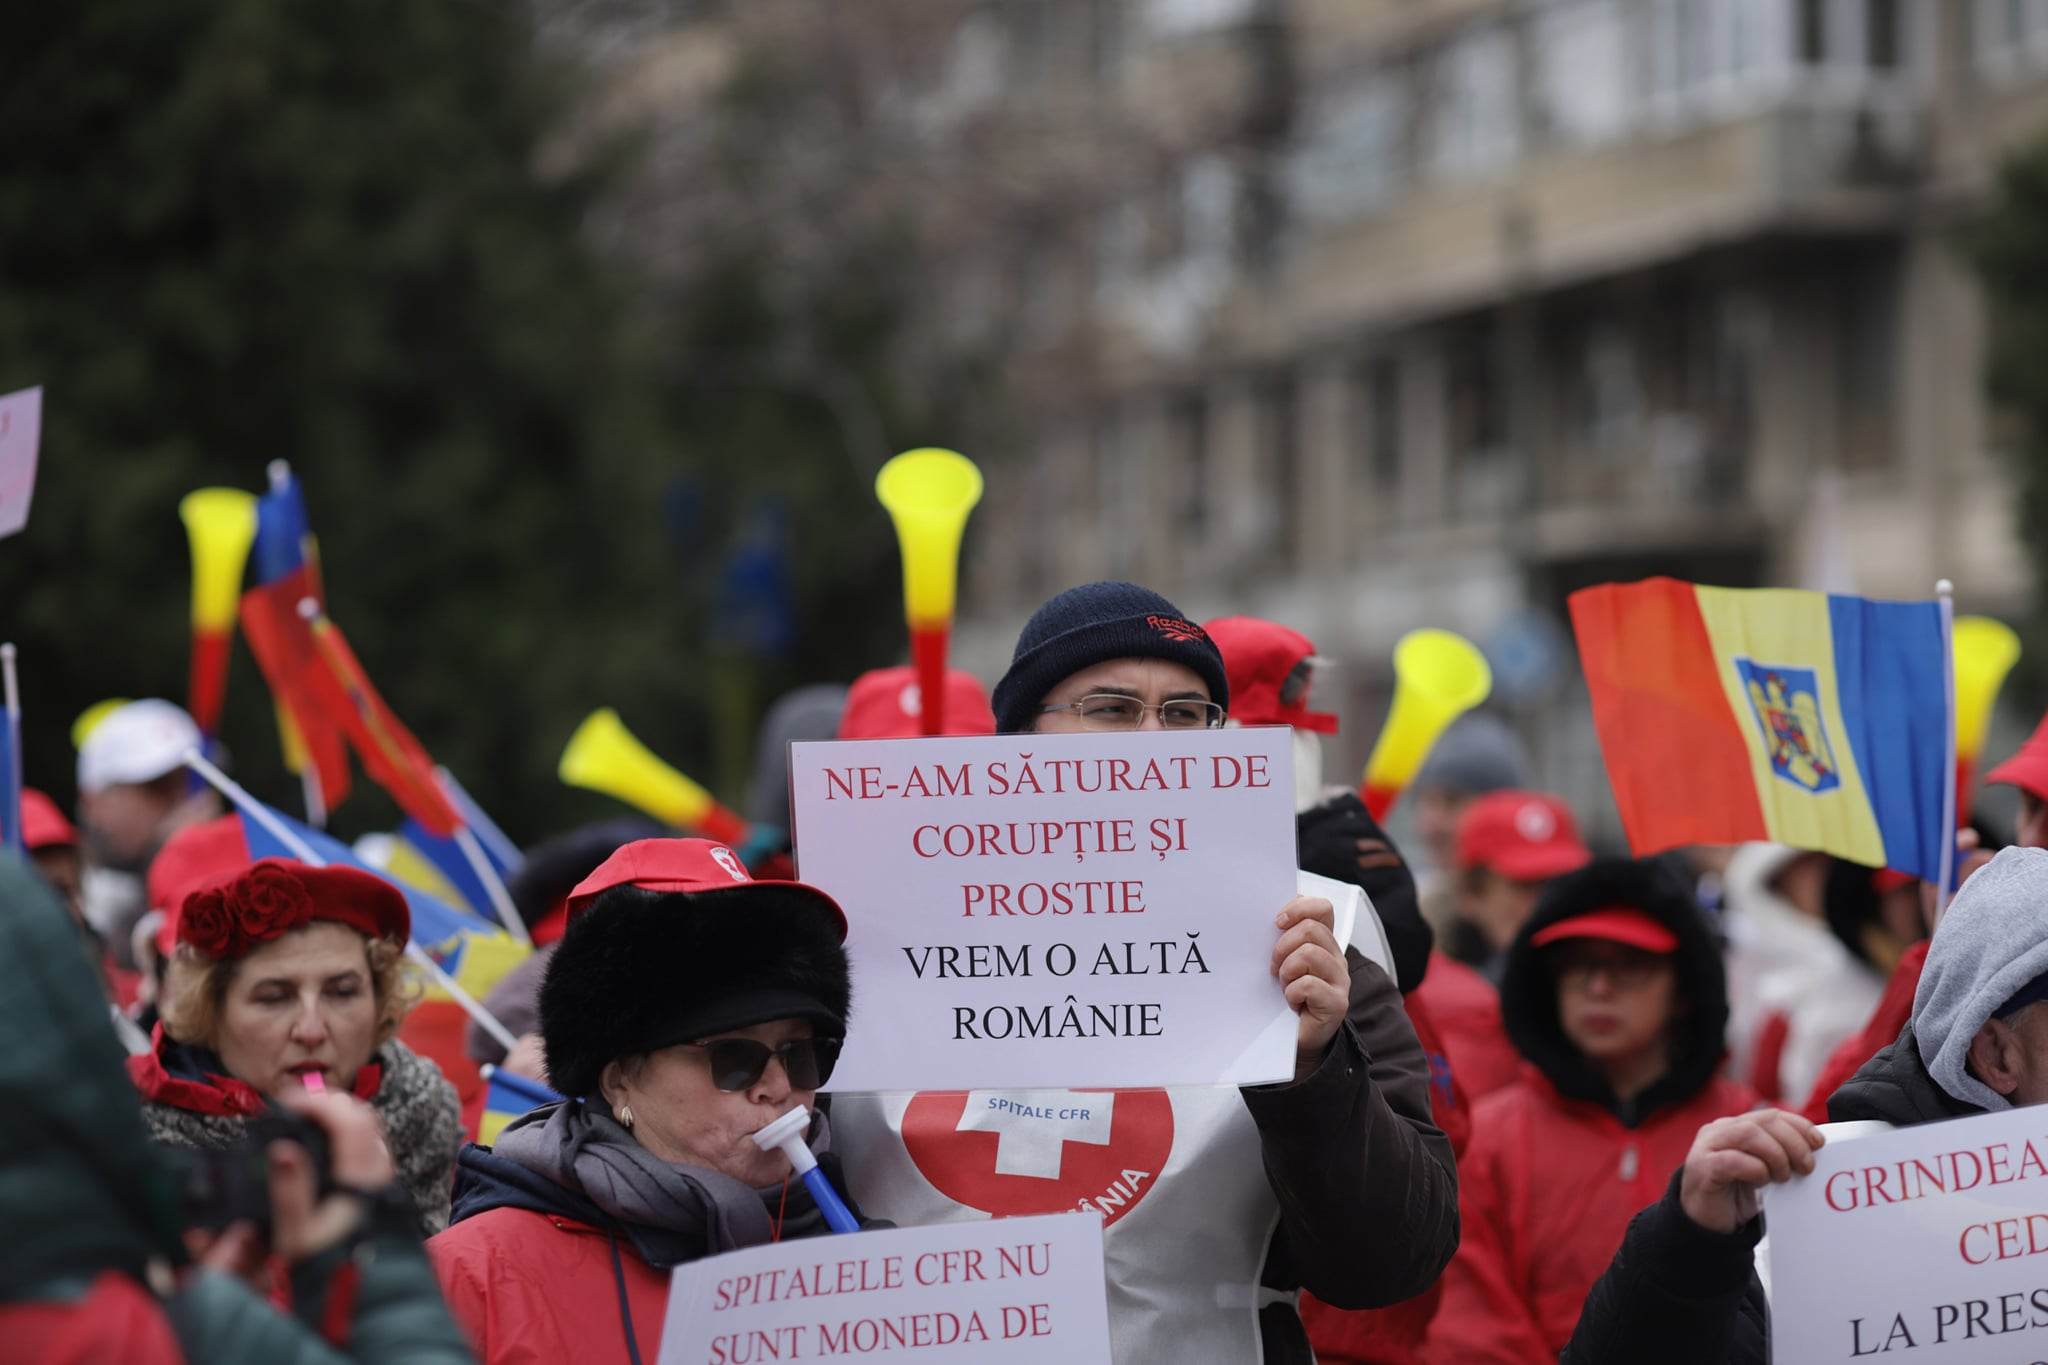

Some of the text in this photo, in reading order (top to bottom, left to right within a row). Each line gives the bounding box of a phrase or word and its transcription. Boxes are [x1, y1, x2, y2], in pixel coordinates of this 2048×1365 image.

[823, 753, 1270, 799] NE-AM SĂTURAT DE
[913, 819, 1188, 863] CORUPȚIE ȘI
[961, 881, 1145, 916] PROSTIE
[901, 932, 1210, 978] VREM O ALTĂ
[952, 995, 1163, 1039] ROMÂNIE
[989, 1098, 1090, 1120] SPITALE CFR
[1068, 1169, 1150, 1219] ÂNIA
[1824, 1136, 2048, 1212] GRINDEA
[713, 1243, 1052, 1311] SPITALELE CFR NU
[709, 1304, 1051, 1365] SUNT MONEDA DE
[1848, 1313, 1918, 1360] LA
